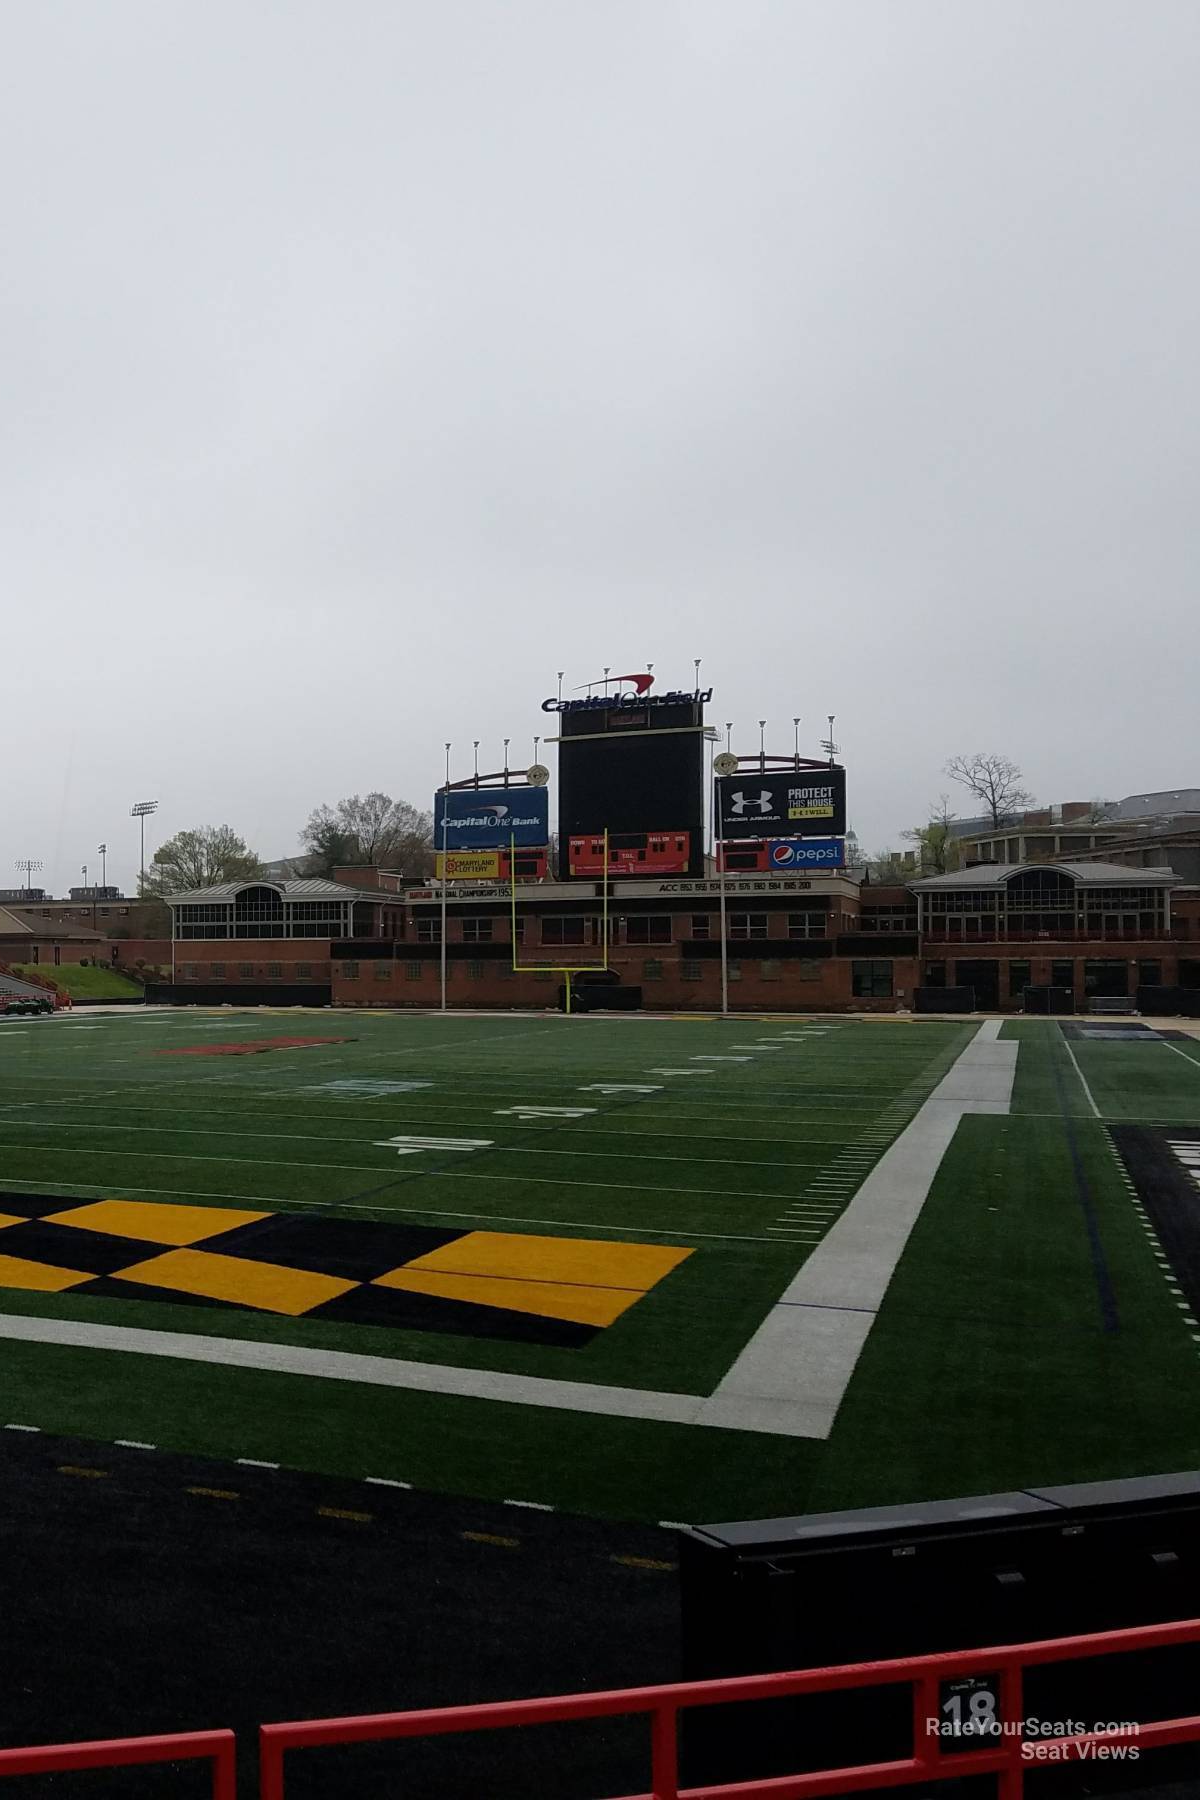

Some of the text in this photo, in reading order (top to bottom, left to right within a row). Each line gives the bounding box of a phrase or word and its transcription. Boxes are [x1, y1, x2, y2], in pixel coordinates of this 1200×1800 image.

[788, 786, 834, 799] PROTECT
[788, 799, 806, 808] THIS
[512, 816, 541, 826] Bank
[749, 814, 782, 822] ARMOUR
[796, 846, 839, 862] pepsi
[459, 865, 487, 873] LOTTERY
[659, 884, 678, 892] ACC
[943, 1690, 996, 1738] 18
